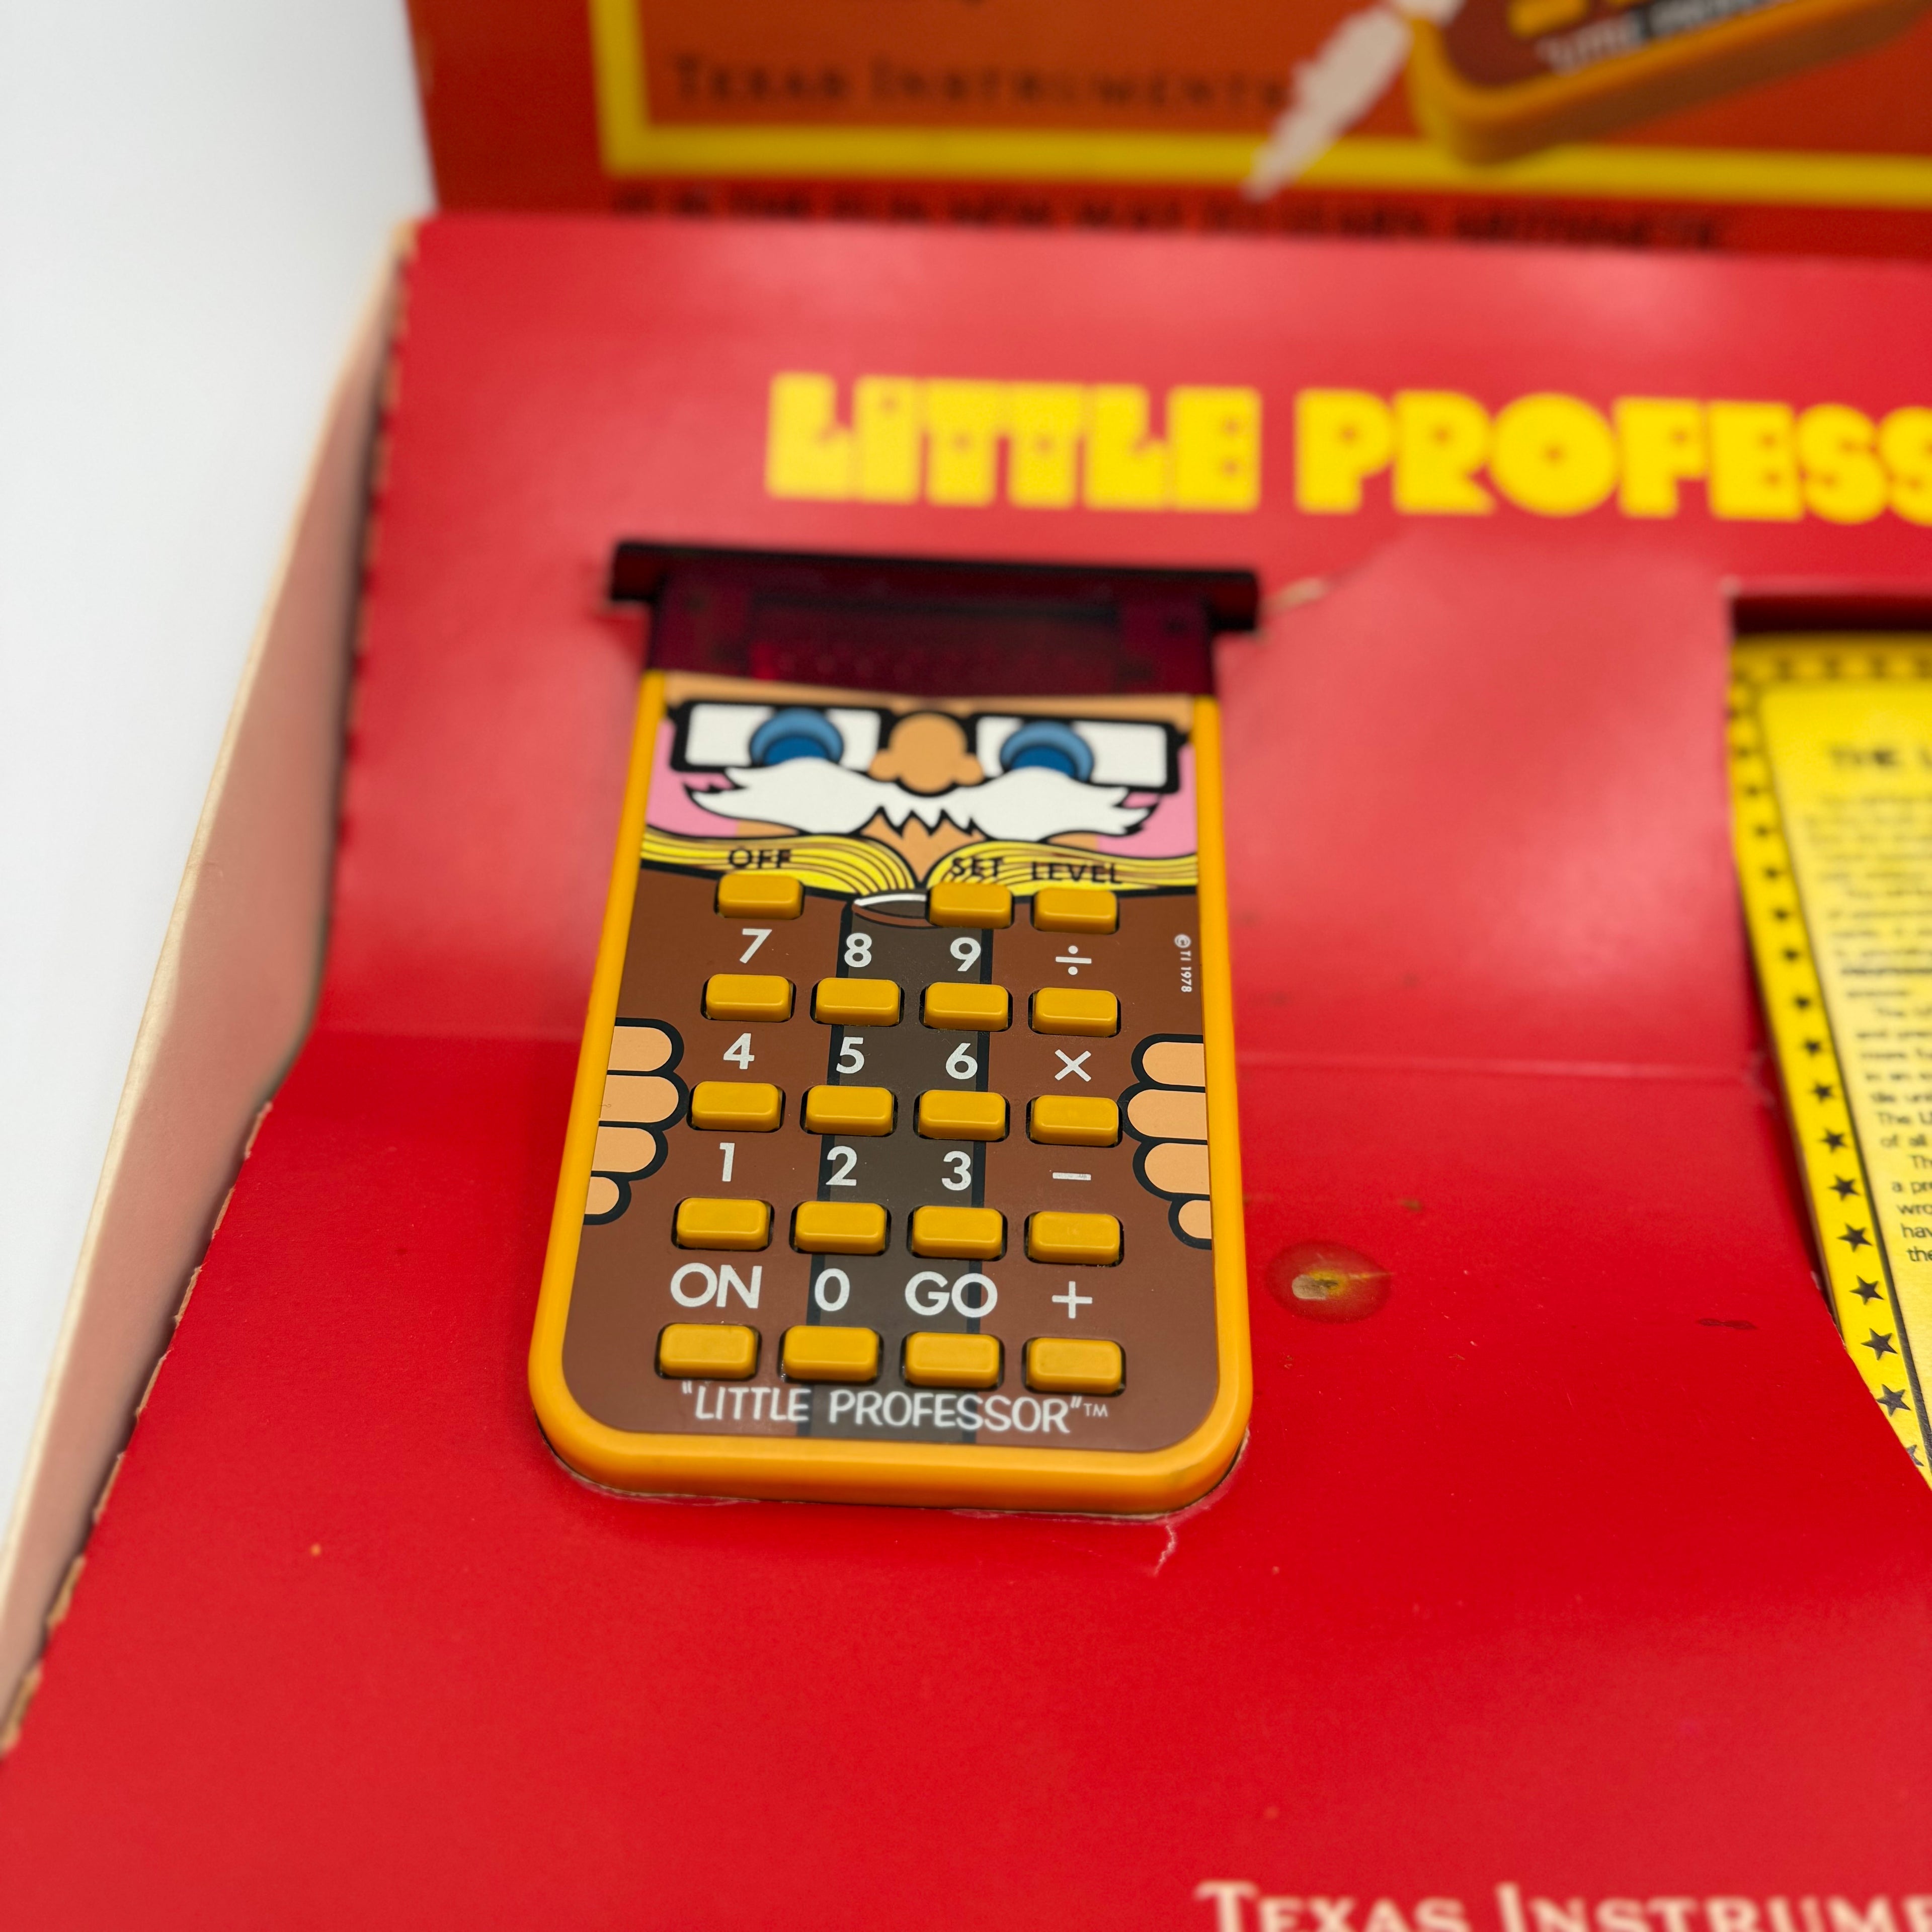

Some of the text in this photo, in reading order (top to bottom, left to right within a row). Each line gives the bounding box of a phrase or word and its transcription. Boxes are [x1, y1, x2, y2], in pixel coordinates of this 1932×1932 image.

[764, 371, 1932, 526] LITTLE PROFESS
[729, 847, 791, 869] OFF
[952, 856, 1123, 884] SET LEVEL
[740, 929, 772, 963] 7
[844, 933, 872, 968] 8
[950, 937, 981, 972] 9
[1180, 967, 1192, 993] 1978
[723, 1033, 755, 1070] 4
[836, 1036, 865, 1074] 5
[945, 1042, 978, 1080] 6
[719, 1143, 735, 1182] 1
[826, 1146, 857, 1186] 2
[941, 1151, 972, 1191] 3
[670, 1262, 763, 1309] ON
[815, 1268, 850, 1312] 0
[905, 1271, 998, 1318] GO
[1194, 1880, 1473, 1932] TEXAS
